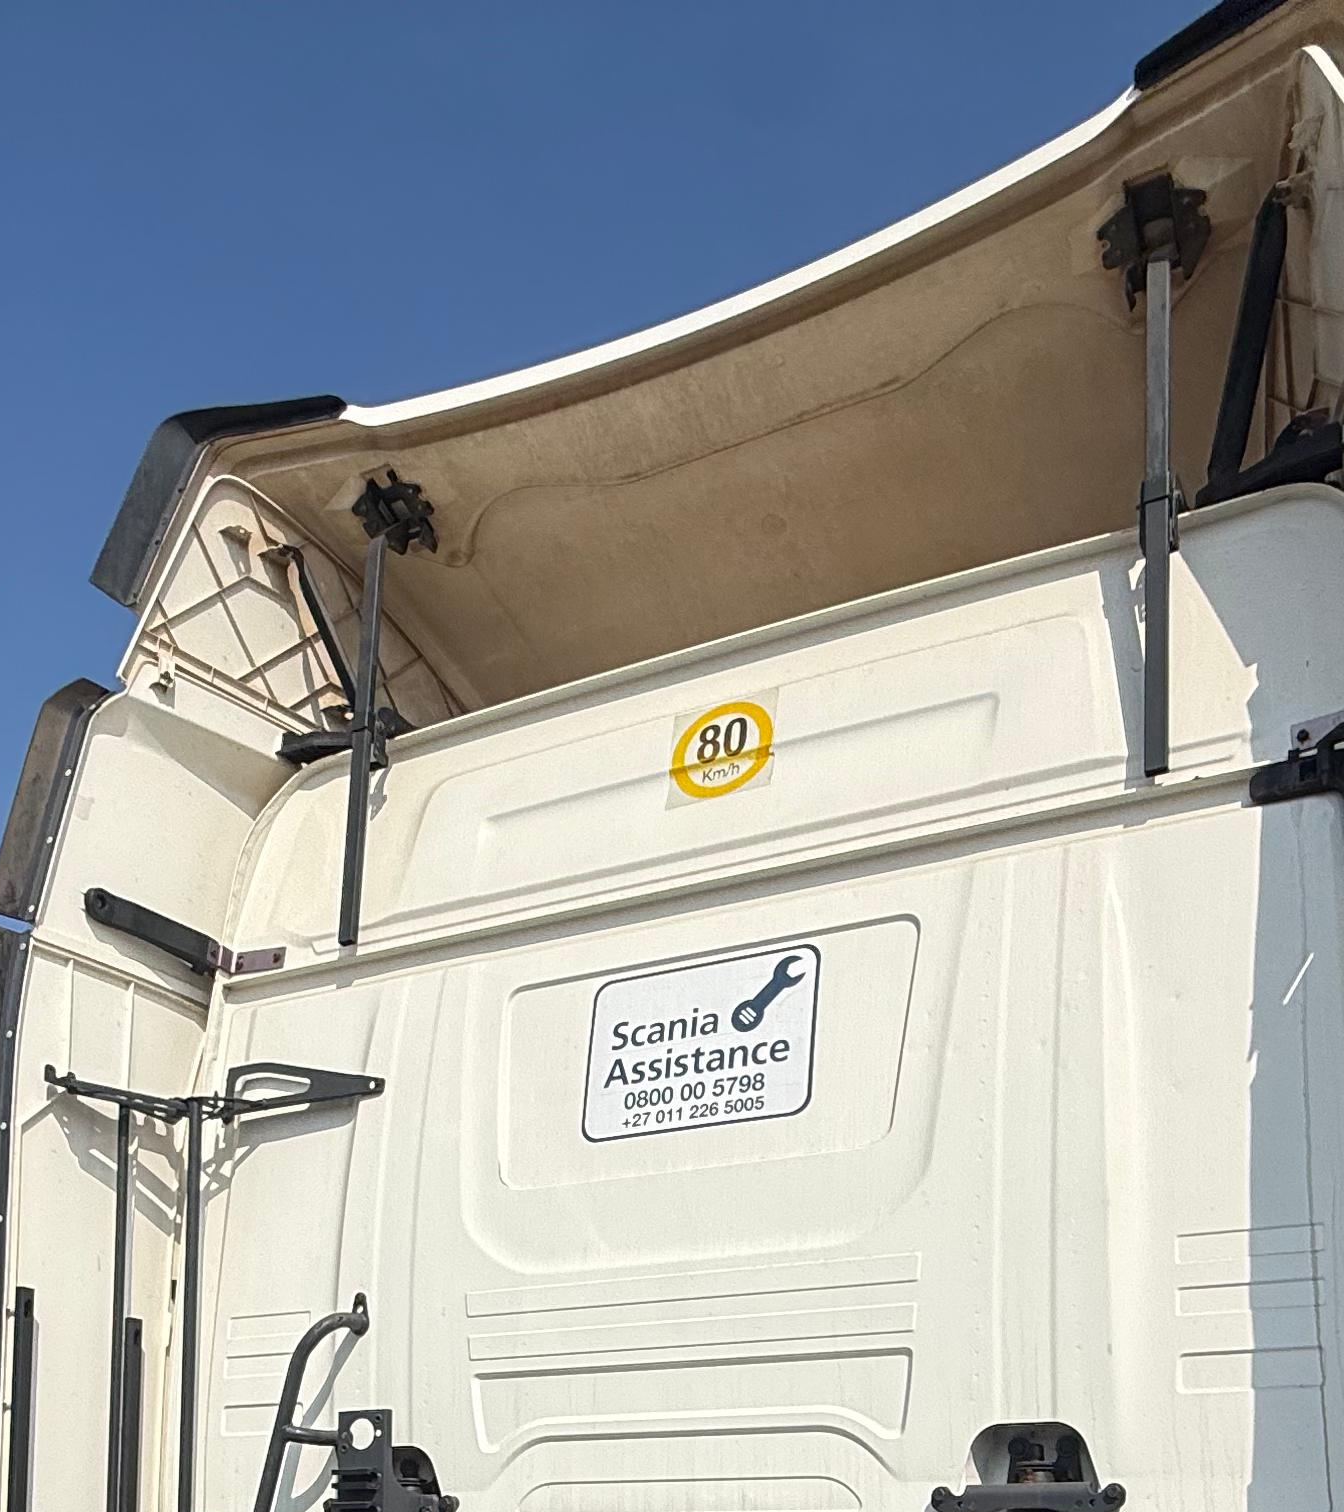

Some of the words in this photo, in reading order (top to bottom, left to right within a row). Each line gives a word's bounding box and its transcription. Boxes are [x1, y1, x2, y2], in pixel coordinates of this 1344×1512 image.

[697, 717, 747, 763] 80
[701, 763, 740, 783] Km/h
[611, 1007, 719, 1051] Scania
[603, 1039, 791, 1089] Assistance
[624, 1086, 674, 1110] 0800
[680, 1081, 706, 1101] 00
[712, 1072, 765, 1097] 5798
[622, 1111, 652, 1129] +27
[655, 1106, 683, 1124] 011
[689, 1102, 719, 1120] 226
[723, 1095, 765, 1115] 5005
